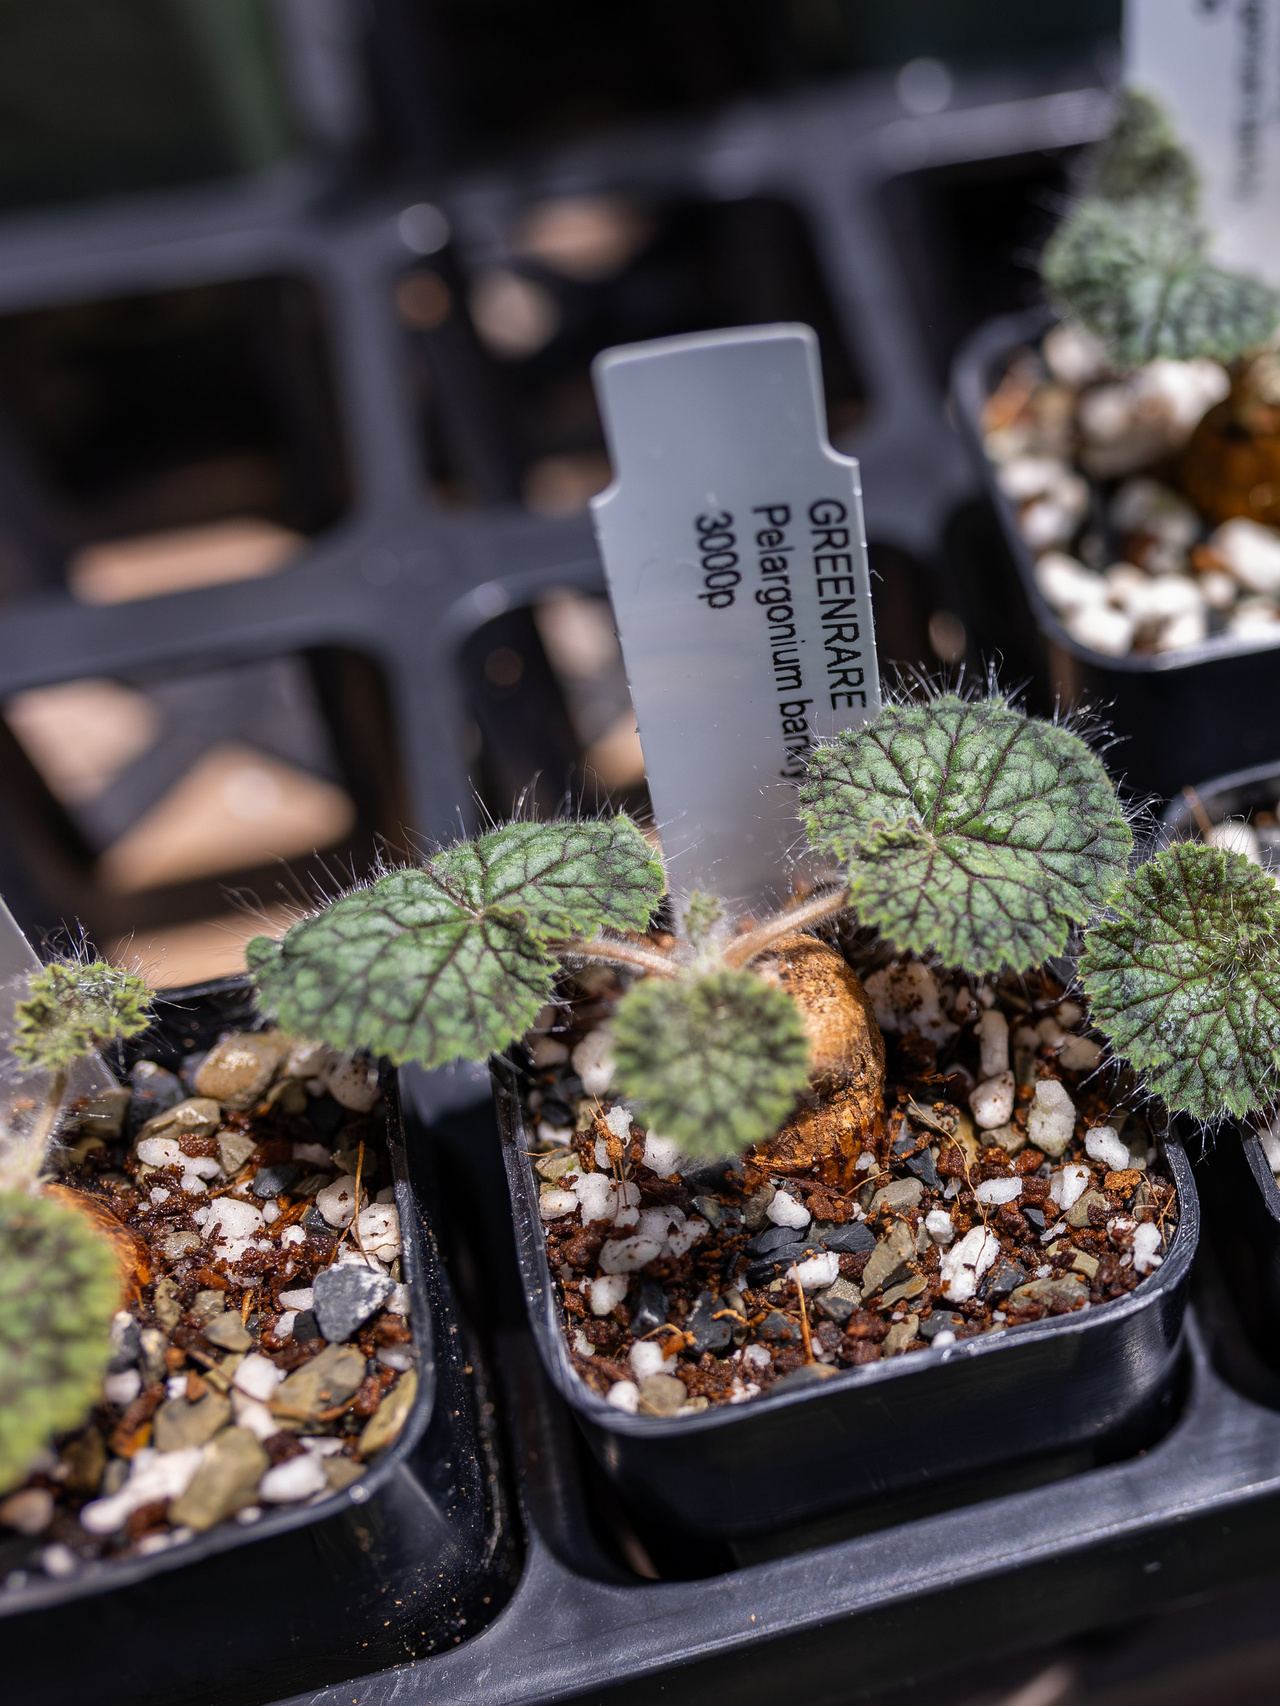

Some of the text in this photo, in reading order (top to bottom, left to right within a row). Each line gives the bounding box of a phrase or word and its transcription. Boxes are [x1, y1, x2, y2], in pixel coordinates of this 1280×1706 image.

[694, 511, 742, 609] 3000p
[752, 504, 818, 788] Pelargonium barkly
[808, 498, 867, 710] GREENRARE
